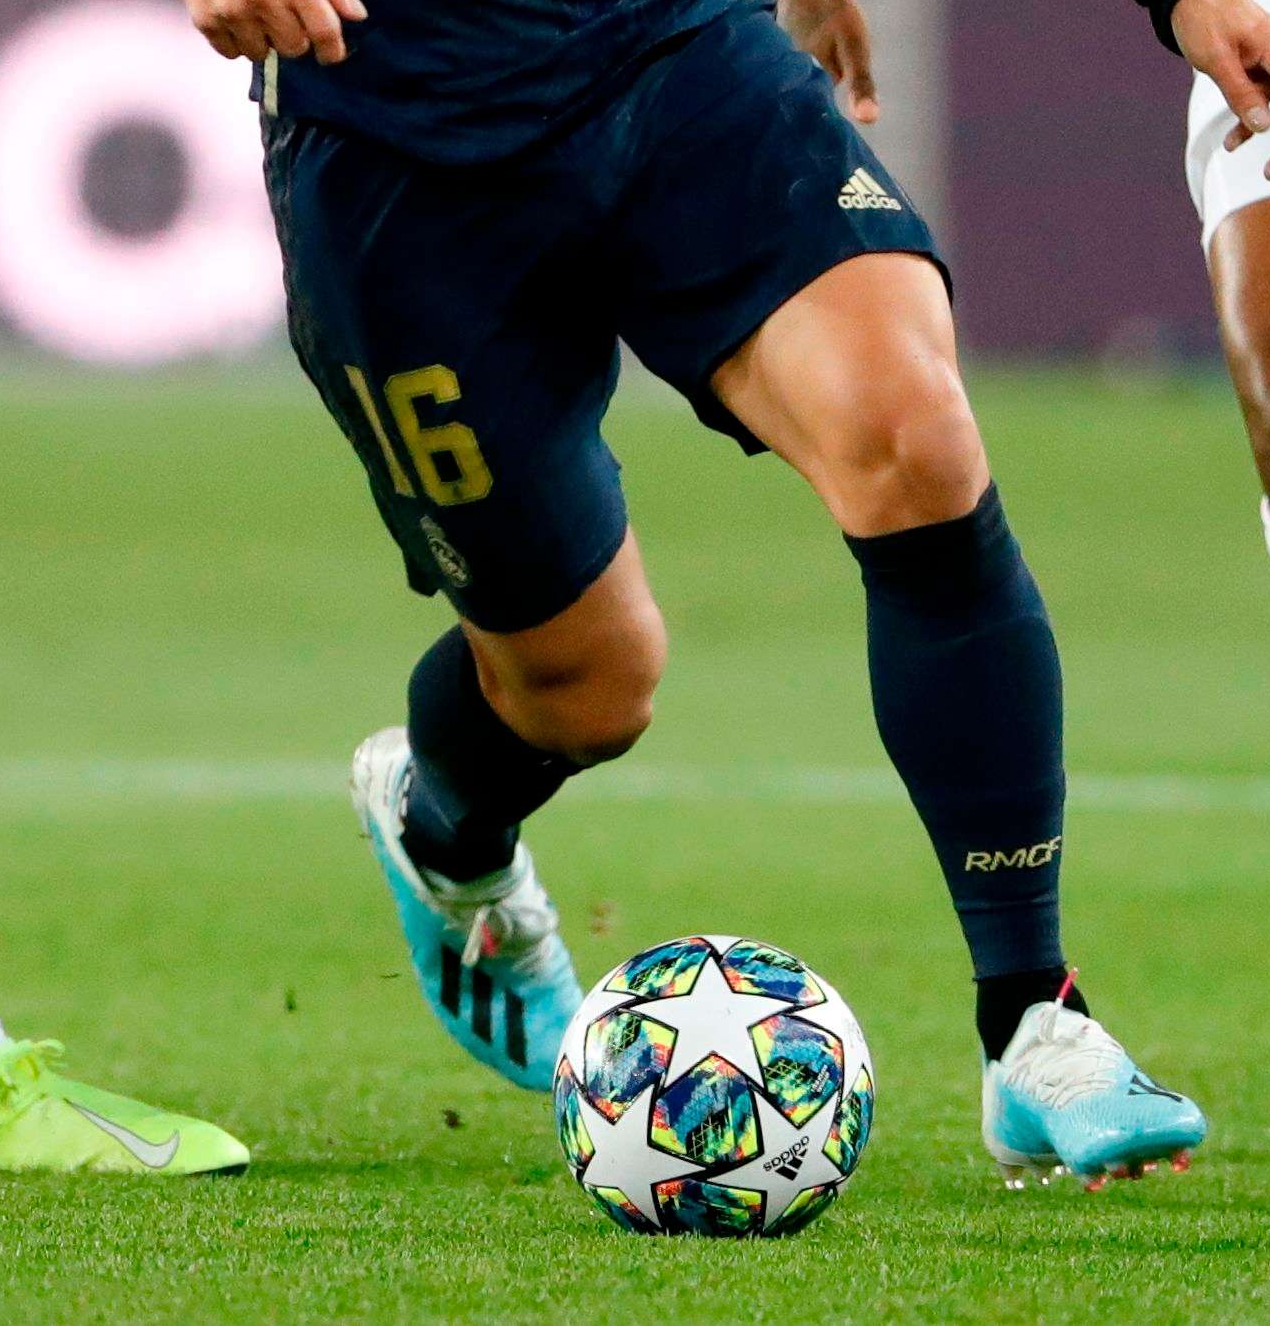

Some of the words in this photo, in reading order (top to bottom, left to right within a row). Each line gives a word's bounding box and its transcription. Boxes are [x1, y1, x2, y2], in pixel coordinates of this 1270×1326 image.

[837, 192, 902, 211] adidas
[344, 364, 494, 507] 16
[762, 1135, 810, 1172] adidas
